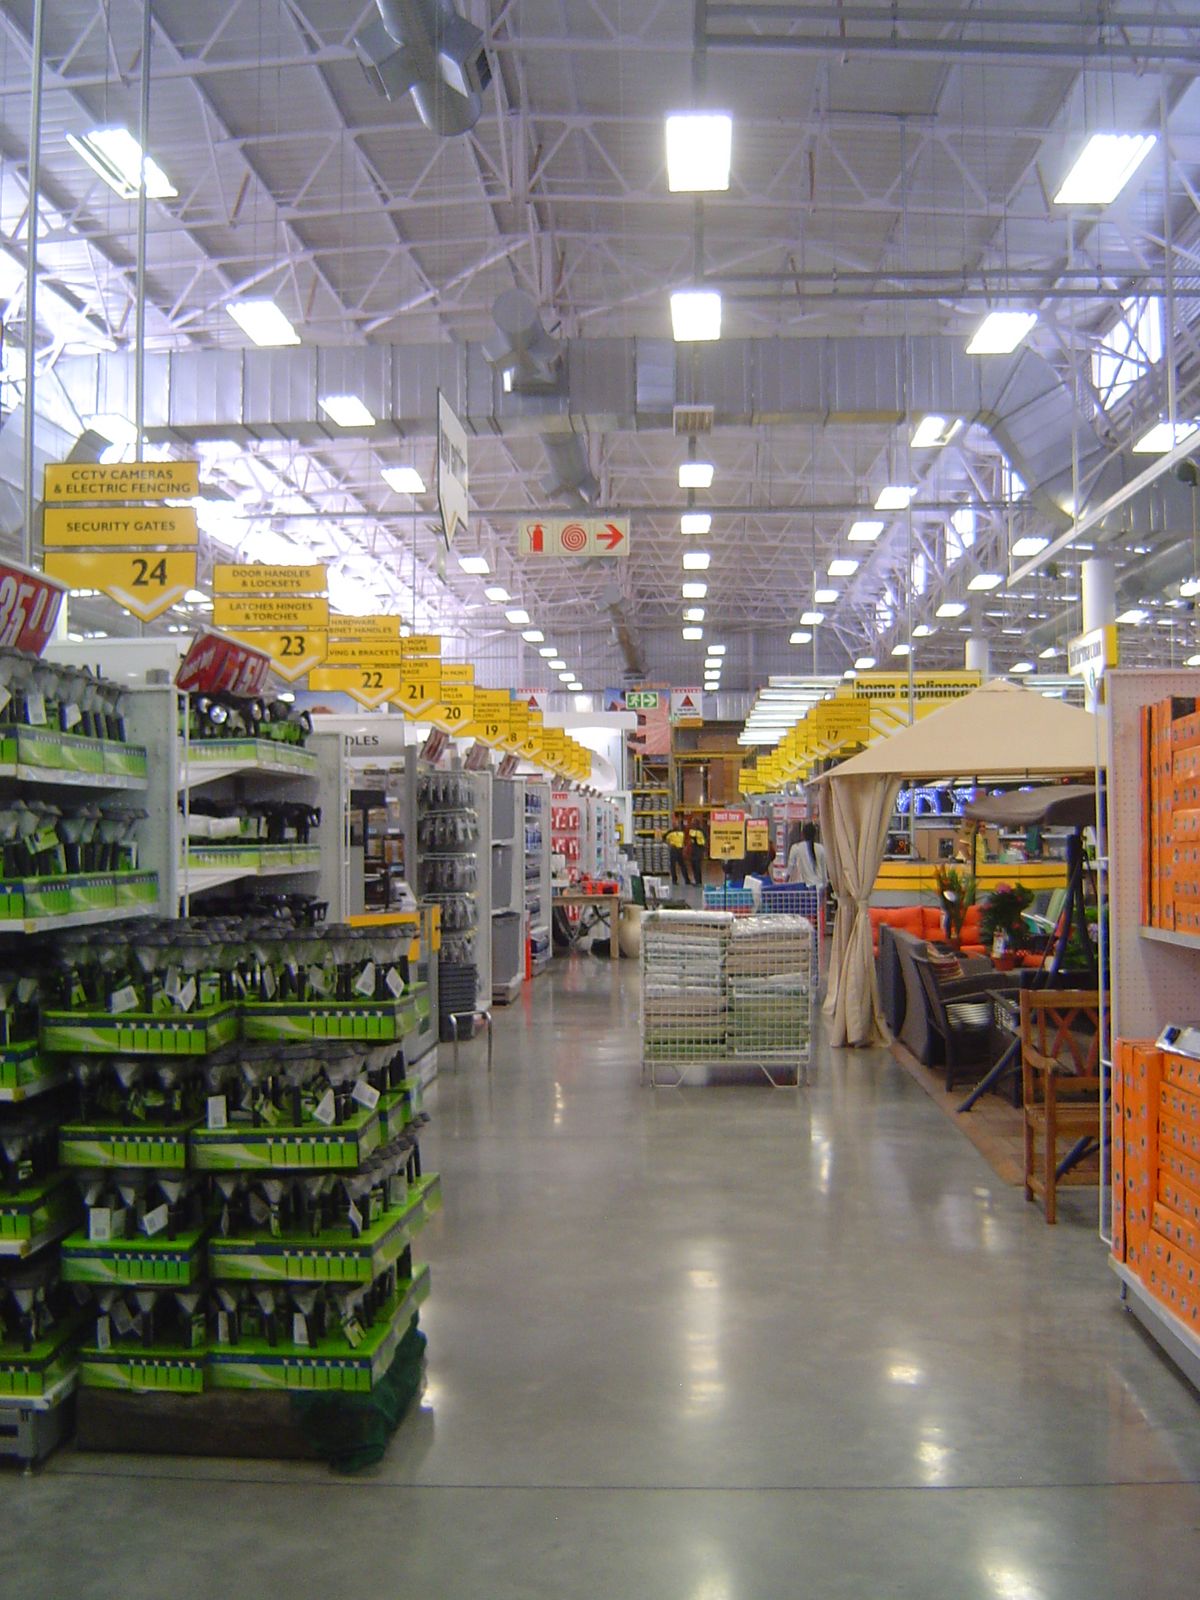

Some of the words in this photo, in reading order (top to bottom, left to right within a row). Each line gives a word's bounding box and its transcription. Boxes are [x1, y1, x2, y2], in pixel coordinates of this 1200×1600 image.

[71, 470, 108, 480] CCTV
[110, 469, 173, 480] CAMERAS
[54, 484, 62, 494] &
[66, 483, 128, 494] ELECTRIC
[131, 482, 191, 493] FENCING
[66, 521, 130, 533] SECURITY
[133, 521, 176, 532] GATES
[131, 558, 168, 587] 24
[232, 569, 262, 578] DOOR
[264, 568, 311, 578] HANDLES
[250, 579, 301, 588] LOCKSETS
[229, 603, 273, 611] LATCHES
[276, 603, 313, 611] HINGES
[280, 635, 305, 657] 23
[361, 671, 384, 689] 22
[408, 684, 425, 699] 21
[856, 682, 895, 698] home
[444, 706, 461, 720] 20
[485, 724, 498, 736] 19
[827, 730, 839, 740] 17
